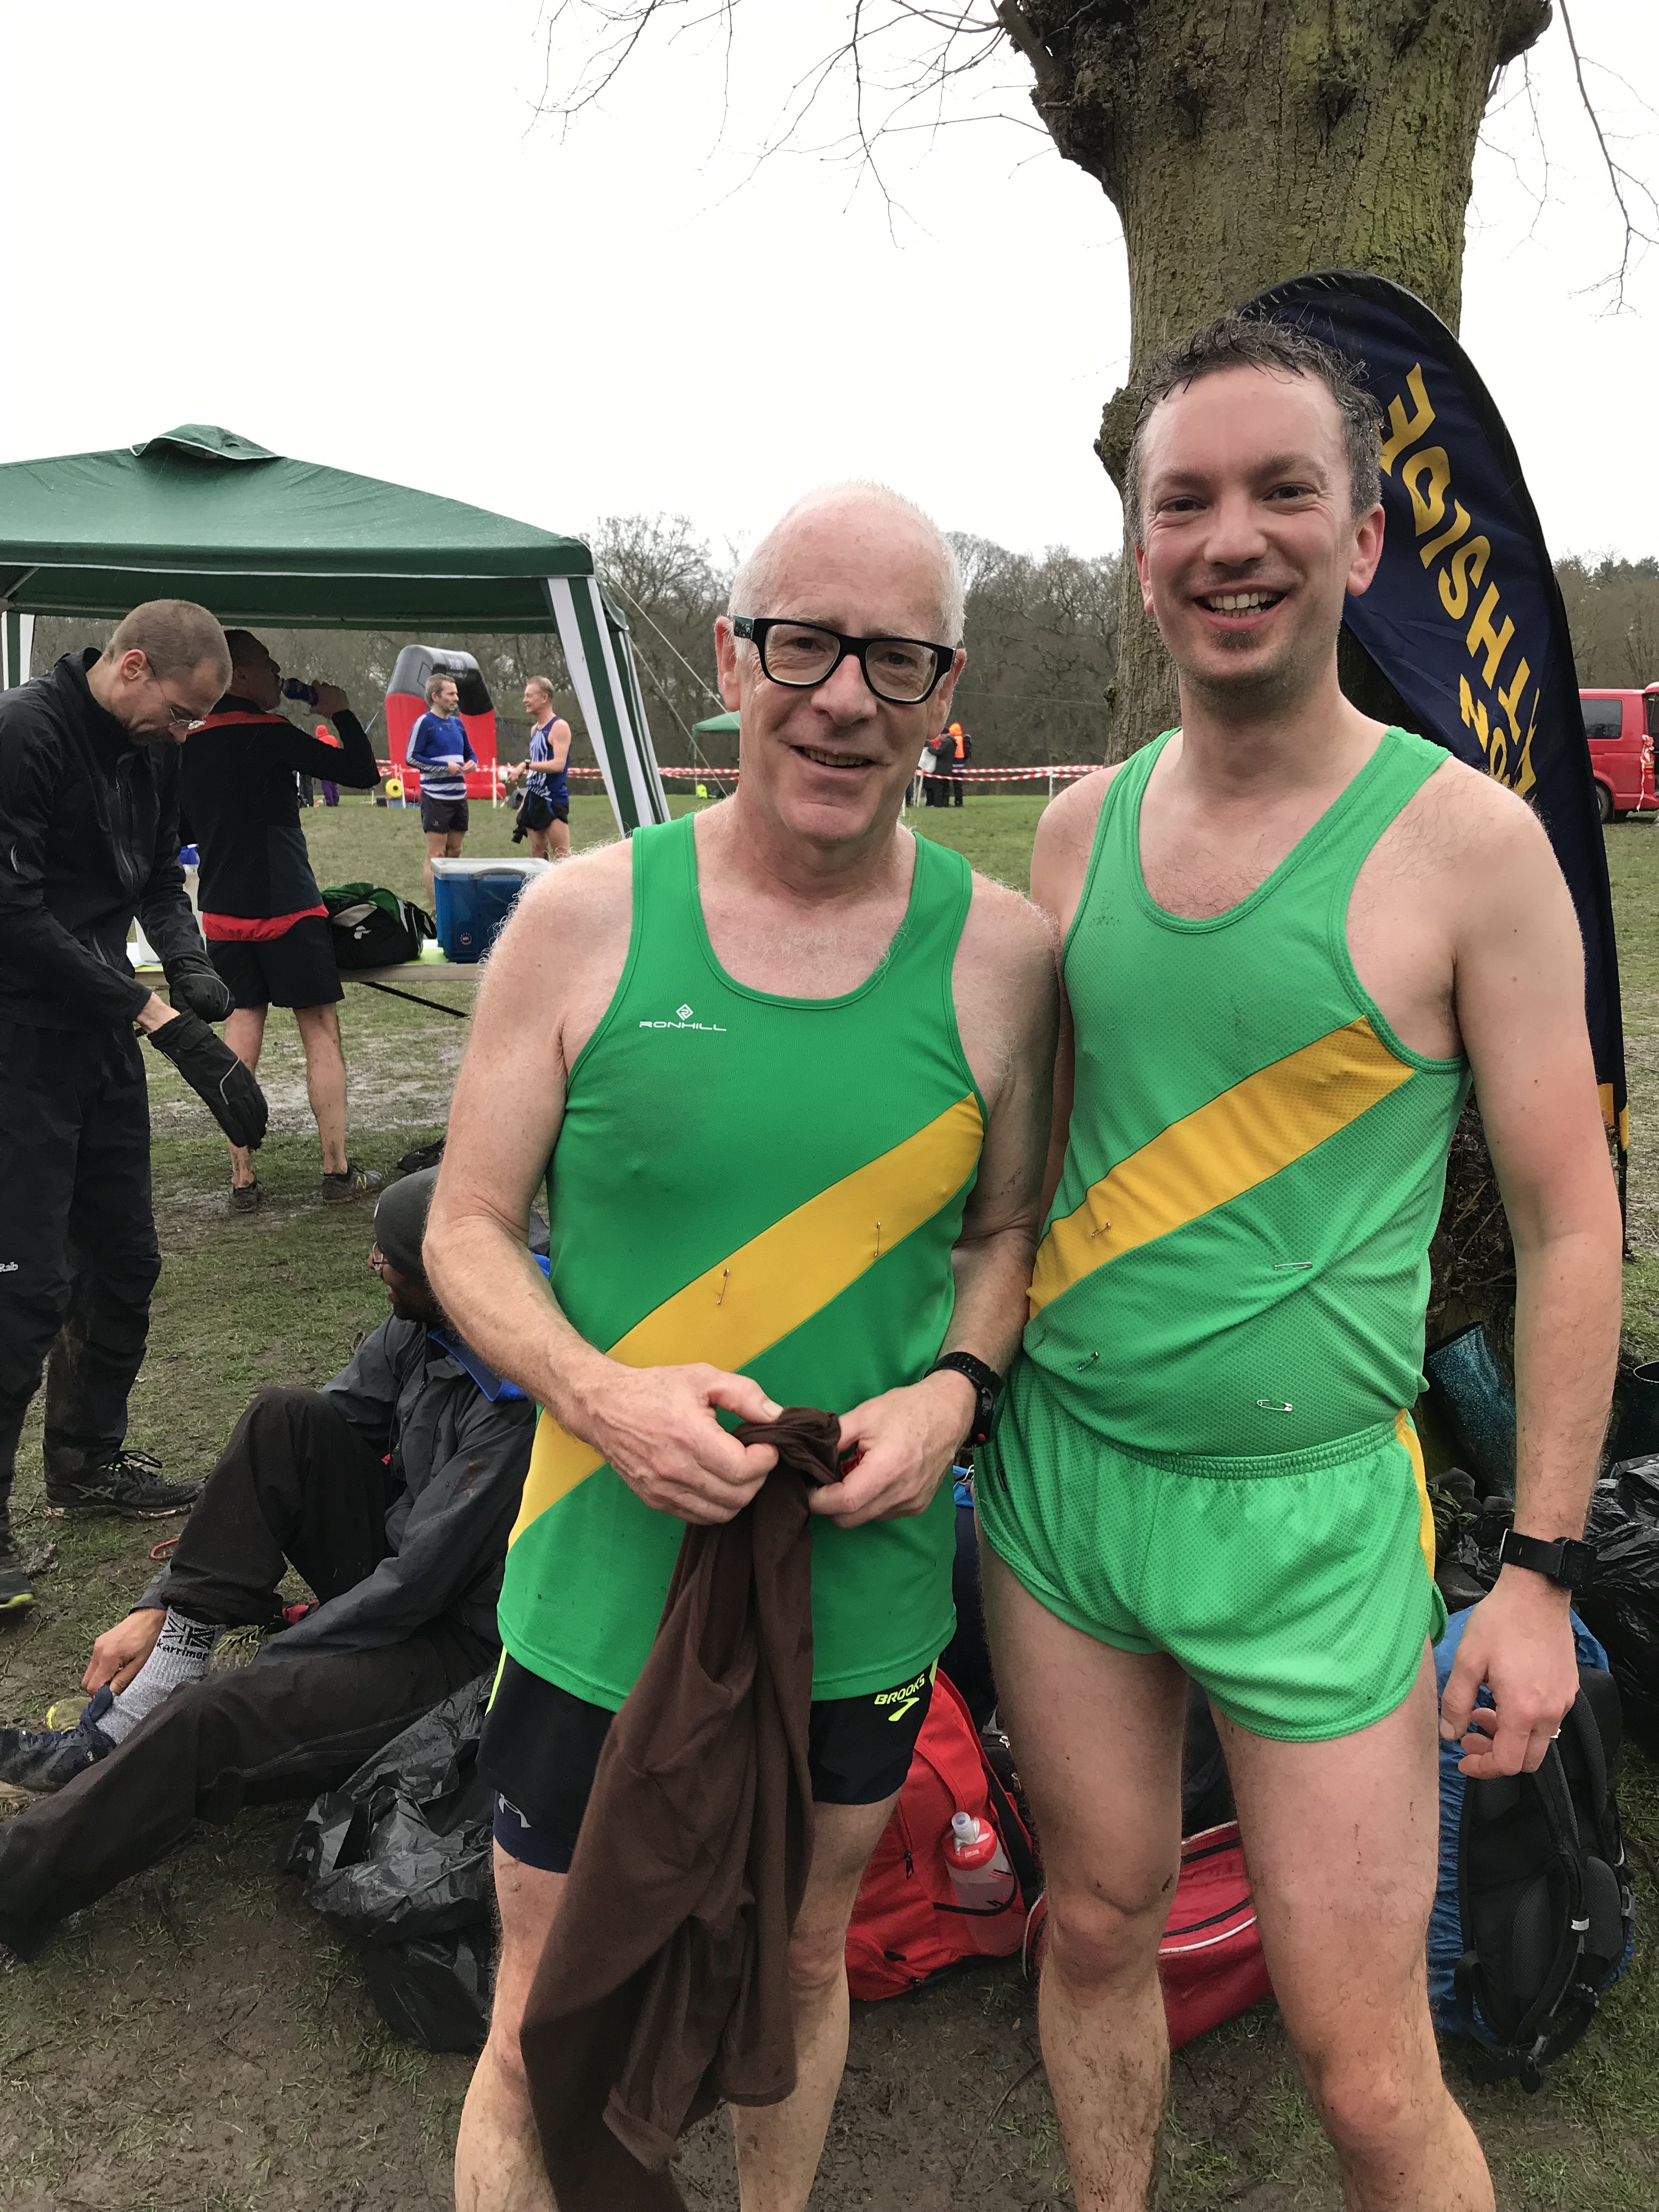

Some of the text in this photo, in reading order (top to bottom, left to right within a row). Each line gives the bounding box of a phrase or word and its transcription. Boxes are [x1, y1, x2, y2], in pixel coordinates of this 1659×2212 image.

[639, 1021, 727, 1031] RONHILL
[156, 1638, 210, 1661] karrimor
[874, 1673, 926, 1705] BROOKS
